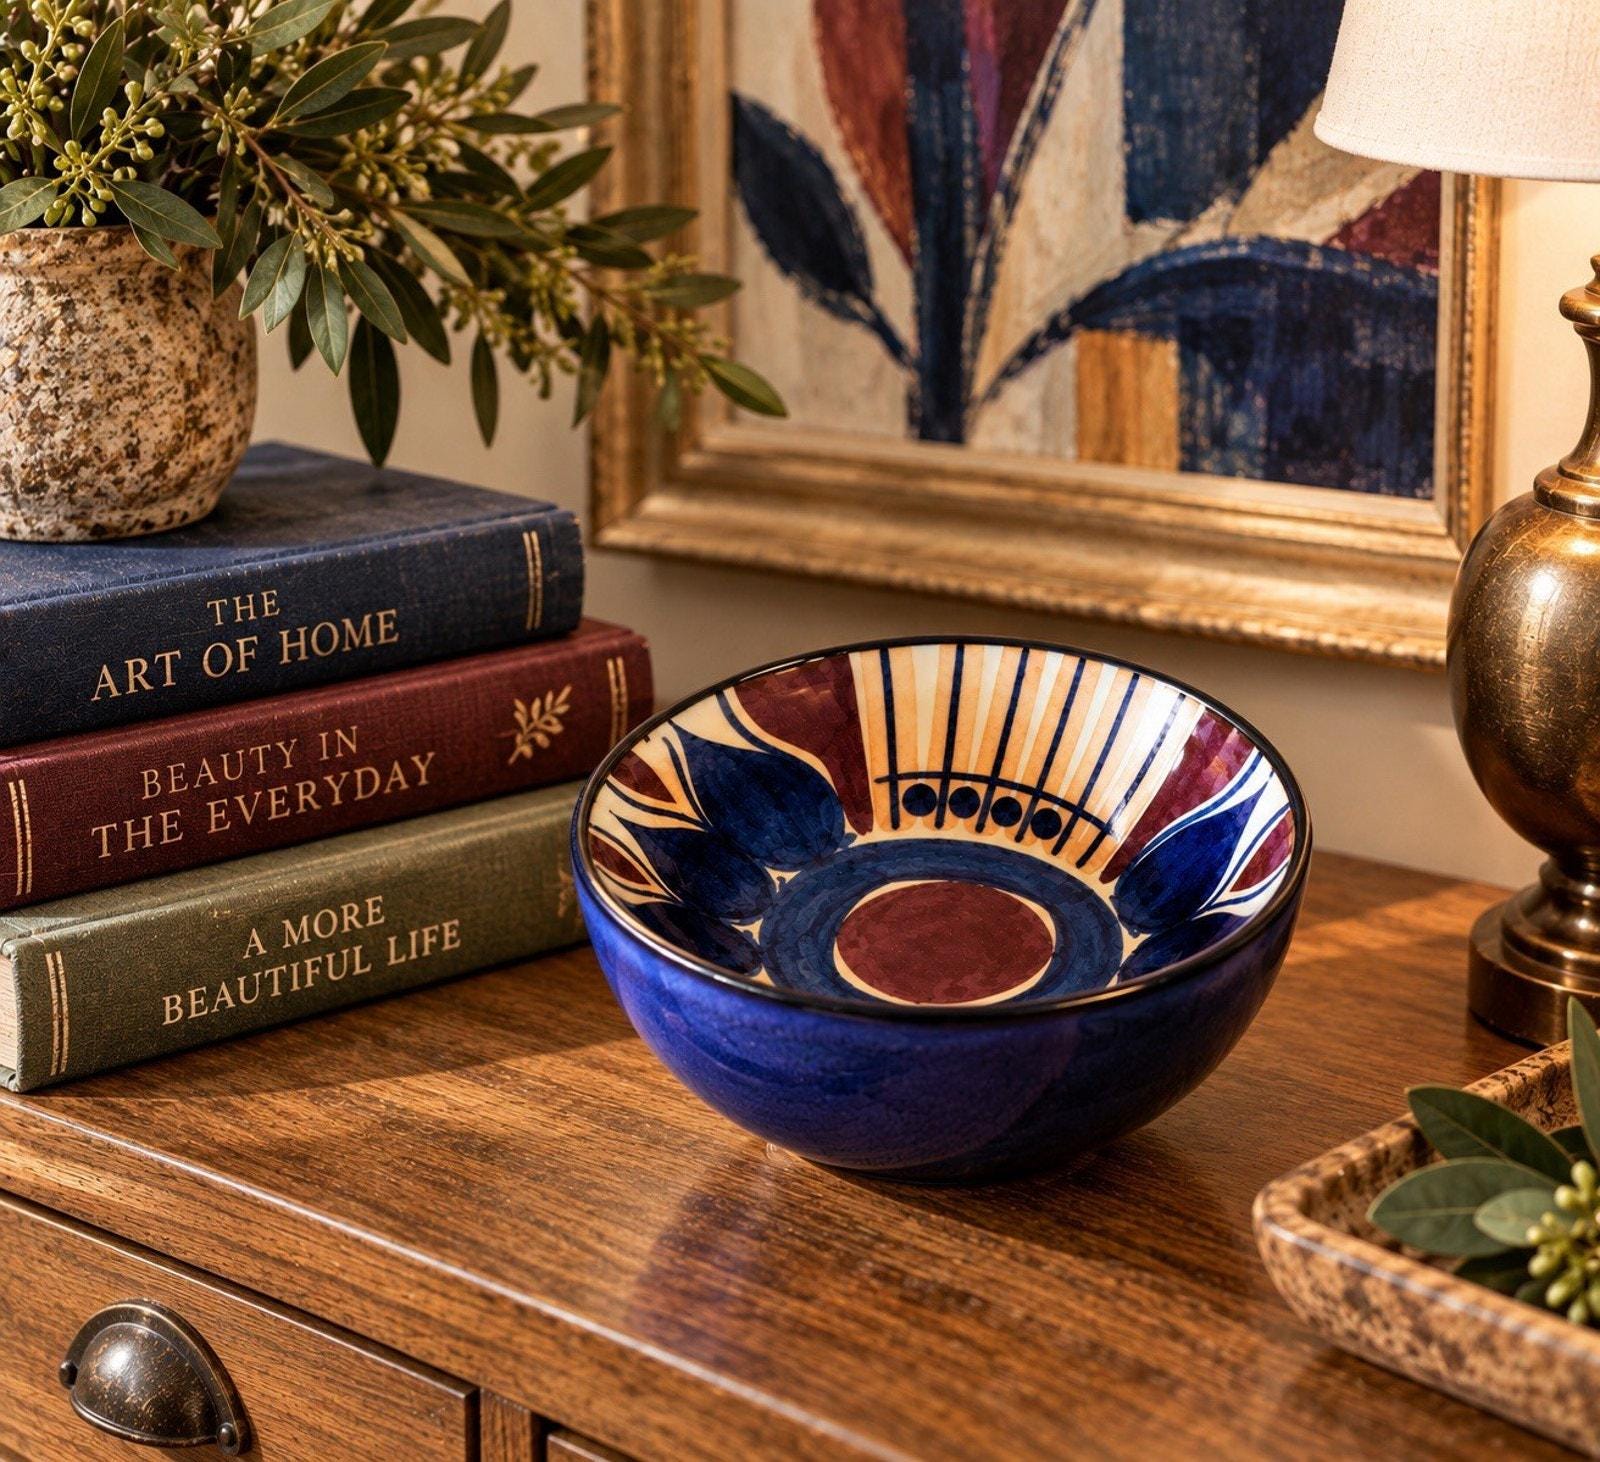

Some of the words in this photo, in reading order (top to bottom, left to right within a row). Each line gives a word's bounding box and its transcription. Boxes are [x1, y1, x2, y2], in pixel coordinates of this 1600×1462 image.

[207, 590, 280, 626] THE
[91, 650, 182, 701] ART
[202, 634, 260, 678] OF
[278, 609, 400, 665] HOME
[141, 738, 298, 800] BEAUTY
[319, 726, 359, 759] IN
[91, 810, 183, 859] THE
[208, 752, 436, 834] EVERYDAY
[242, 928, 267, 960] A
[281, 895, 385, 947] MORE
[162, 945, 371, 1025] BEAUTIFUL
[387, 919, 461, 965] LIFE
